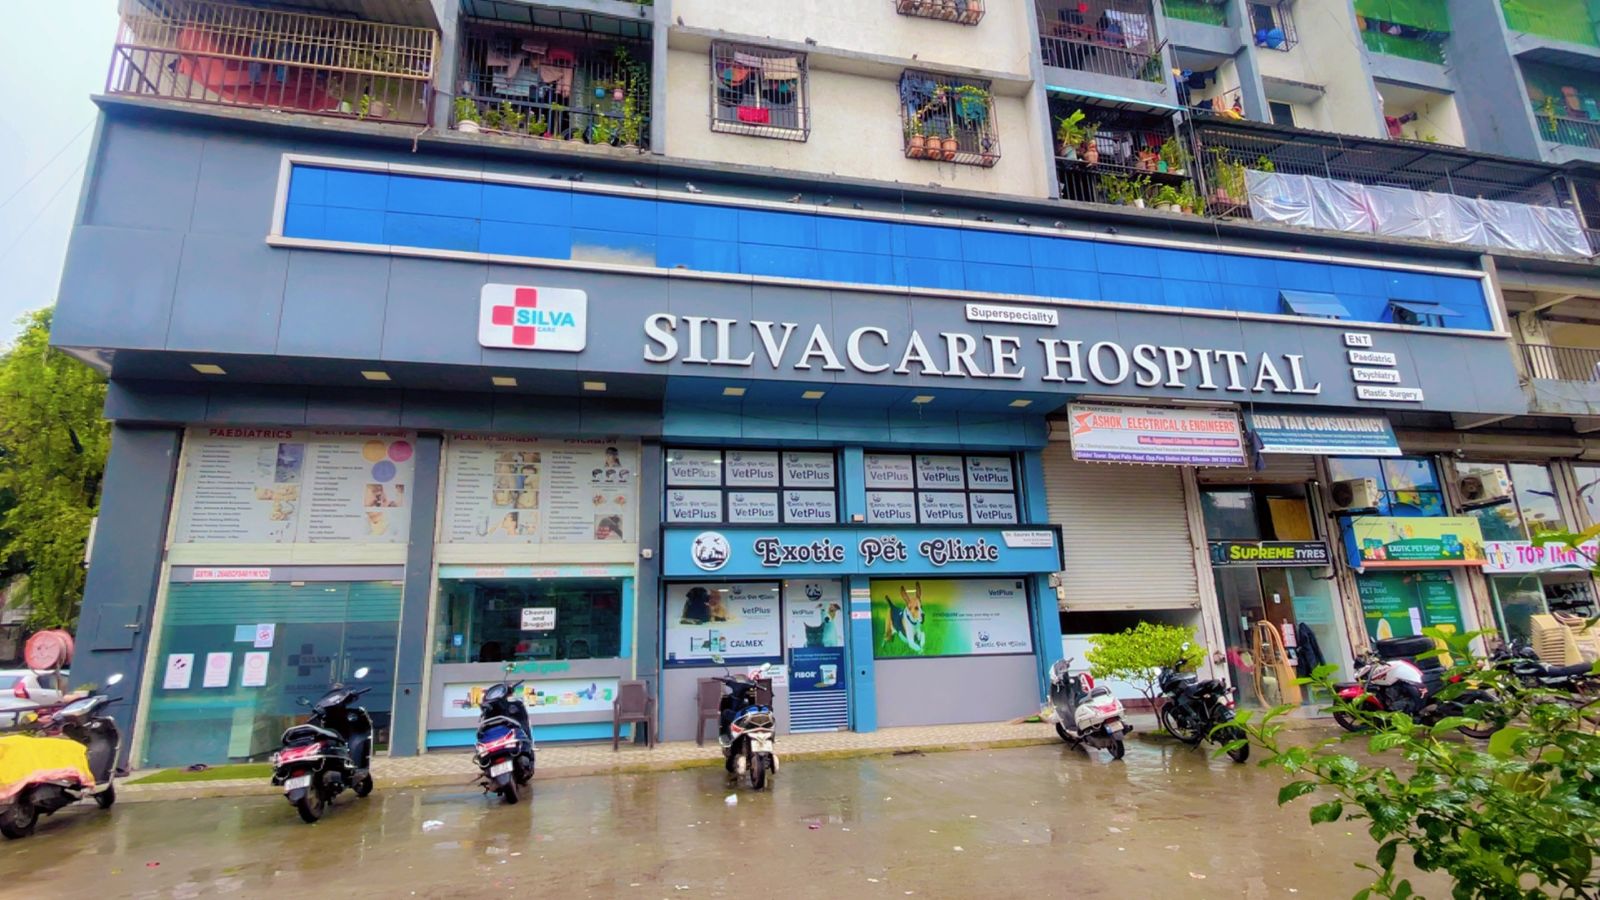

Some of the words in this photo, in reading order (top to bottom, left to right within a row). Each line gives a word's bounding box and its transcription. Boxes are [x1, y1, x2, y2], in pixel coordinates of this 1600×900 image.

[516, 309, 575, 327] SILVA
[970, 307, 1054, 323] Superspeciality
[1348, 335, 1368, 344] ENT
[643, 313, 1026, 379] SILVACARE
[1038, 338, 1321, 395] HOSPITAL
[1353, 352, 1392, 363] Paediatric
[1357, 370, 1396, 380] Psychiatry
[1363, 388, 1387, 397] Plastic
[1388, 389, 1418, 399] Surgery
[1092, 414, 1122, 429] ASHOK
[1127, 416, 1178, 431] ELECTRICAL
[1181, 419, 1188, 432] &
[1189, 420, 1235, 433] ENGINEERS
[1251, 414, 1281, 429] HRM
[1280, 415, 1306, 430] TAX
[1305, 416, 1384, 432] CONSULTANCY
[209, 429, 292, 438] PAEDIATRICS
[672, 468, 716, 477] VetPlus
[732, 469, 774, 478] VetPlus
[789, 469, 830, 479] VetPlus
[870, 471, 908, 480] VetPlus
[923, 472, 960, 481] VetPlus
[973, 473, 1008, 482] VetPlus
[673, 508, 717, 518] VetPlus
[735, 508, 774, 516] VetPlus
[790, 508, 831, 518] VetPlus
[873, 509, 911, 518] VetPlus
[926, 509, 963, 518] VetPlus
[976, 511, 1013, 519] VetPlus
[755, 537, 845, 566] Exotic
[920, 538, 999, 566] Clinic
[1230, 545, 1294, 559] SUPREME
[1295, 549, 1326, 559] TYRES
[1516, 545, 1544, 564] TOP
[730, 640, 763, 648] CALMEX
